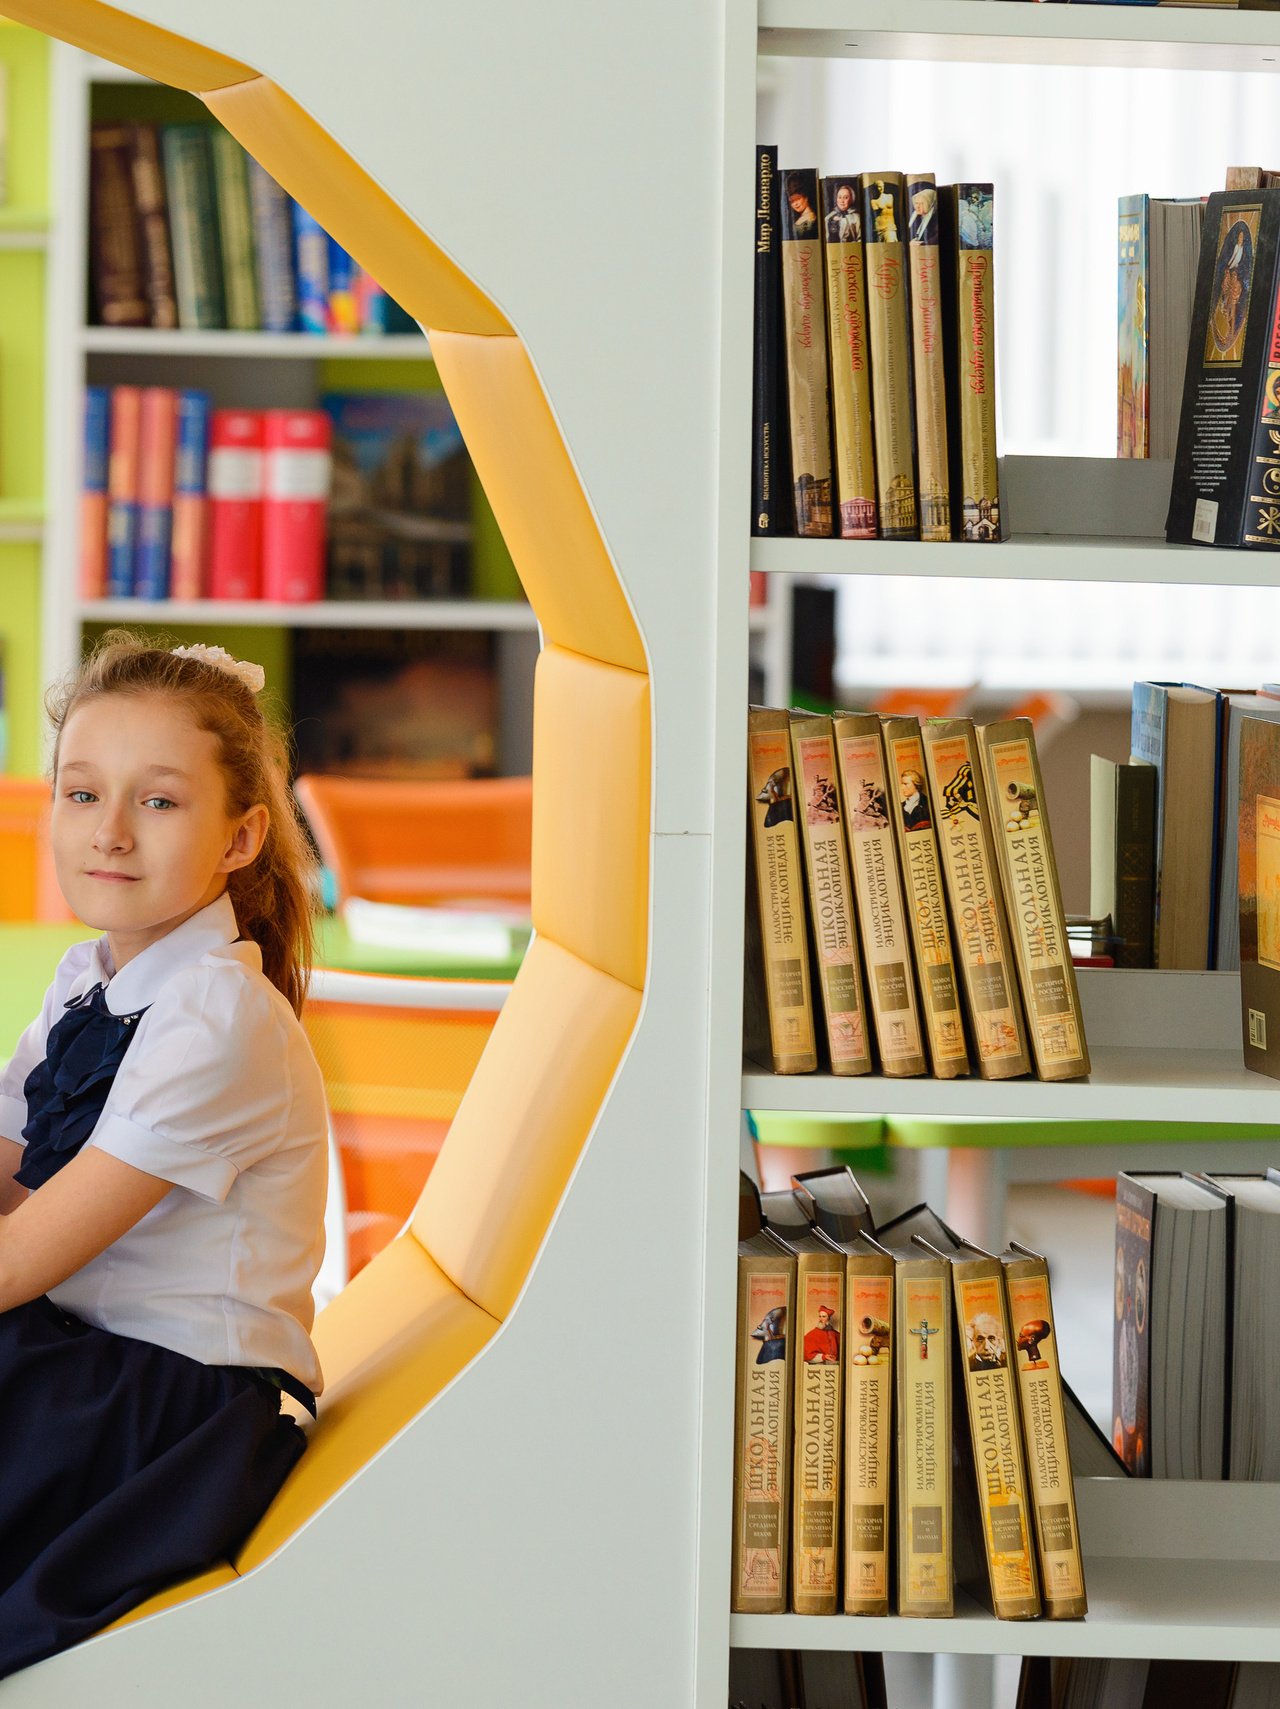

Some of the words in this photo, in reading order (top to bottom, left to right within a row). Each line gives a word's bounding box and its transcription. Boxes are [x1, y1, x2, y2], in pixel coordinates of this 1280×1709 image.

[758, 154, 773, 220] Леонардо
[758, 224, 773, 253] Мир
[840, 255, 862, 302] Русские
[967, 256, 987, 346] Третьяковская
[843, 303, 864, 371] художники
[970, 349, 986, 395] галерея
[890, 414, 898, 465] ЖИВОПИСИ
[767, 835, 782, 944] ИЛЛЮСТРИРОВАННАЯ
[776, 833, 794, 944] ЭНЦИКЛОПЕДИЯ
[813, 840, 837, 949] ШКОЛЬНАЯ
[827, 839, 848, 949] ЭНЦИКЛОПЕДИЯ
[862, 840, 884, 948] ИЛЛЮСТРИРОВАННАЯ
[872, 838, 895, 948] ЭНЦИКЛОПЕДИЯ
[909, 841, 936, 949] ШКОЛЬНАЯ
[922, 839, 947, 948] ЭНЦИКЛОПЕДИЯ
[951, 834, 983, 955] ШКОЛЬНАЯ
[967, 832, 997, 953] ЭНЦИКЛОПЕДИЯ
[1013, 837, 1044, 959] ШКОЛЬНАЯ
[1028, 835, 1058, 957] ЭНЦИКЛОПЕДИЯ
[880, 983, 905, 991] РОССИИ
[1038, 987, 1063, 996] РОССИИ
[749, 1370, 766, 1491] ШКОЛЬНАЯ
[767, 1370, 780, 1491] ЭНЦИКЛОПЕДИЯ
[804, 1369, 820, 1490] ШКОЛЬНАЯ
[823, 1369, 837, 1491] ЭНЦИКЛОПЕДИЯ
[858, 1380, 868, 1488] ИЛЛЮСТРИРОВАННАЯ
[868, 1379, 880, 1489] ЭНЦИКЛОПЕДИЯ
[926, 1381, 937, 1491] ЭНЦИКЛОПЕДИЯ
[976, 1375, 1003, 1497] ШКОЛЬНАЯ
[993, 1373, 1017, 1495] ЭНЦИКЛОПЕДИЯ
[1029, 1382, 1048, 1488] ИЛЛЮСТРИРОВАННАЯ
[1039, 1379, 1060, 1488] ЭНЦИКЛОПЕДИЯ
